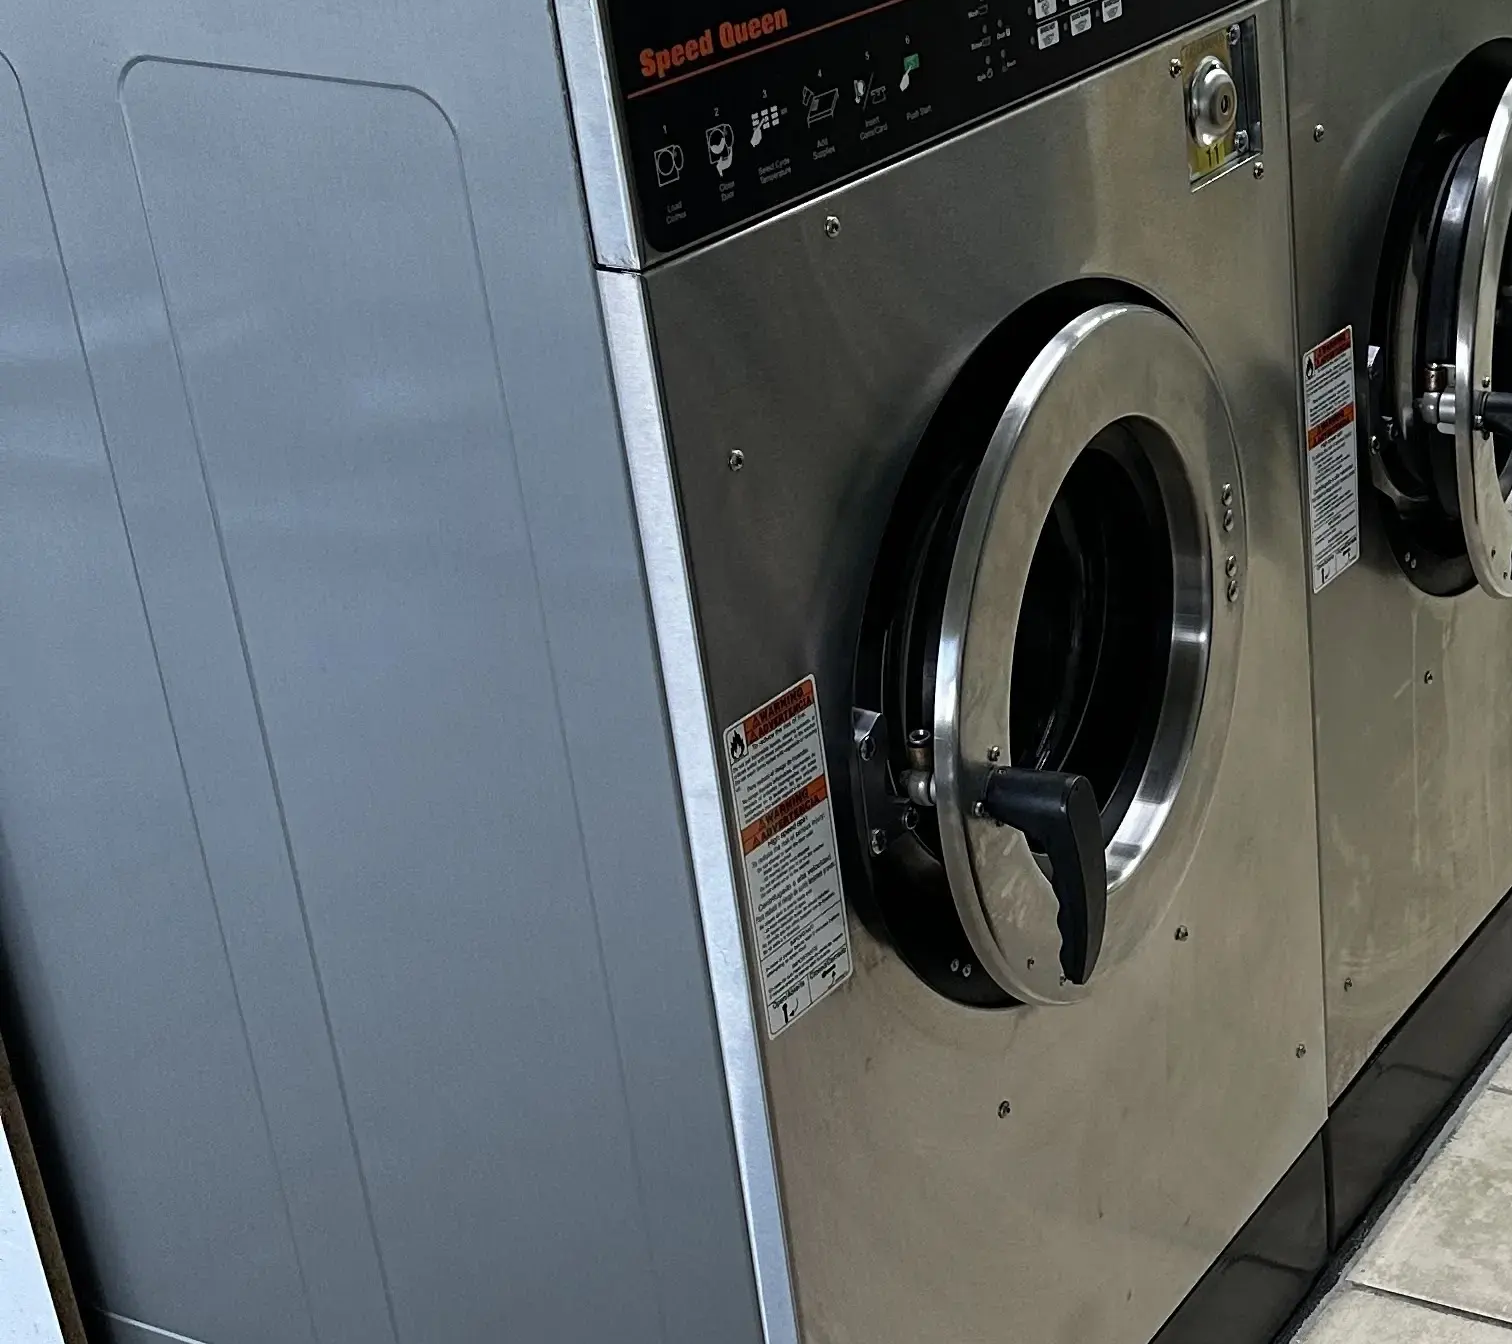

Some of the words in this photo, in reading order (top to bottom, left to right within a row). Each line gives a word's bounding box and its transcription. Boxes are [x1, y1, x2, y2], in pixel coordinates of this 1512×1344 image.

[639, 28, 714, 78] Speed
[719, 8, 788, 49] Queen
[1206, 145, 1220, 168] 11
[758, 694, 811, 737] ADVERTENCIA
[759, 685, 803, 723] WARNING
[760, 792, 819, 842] ADVERTENCIA
[766, 786, 808, 824] WARNING
